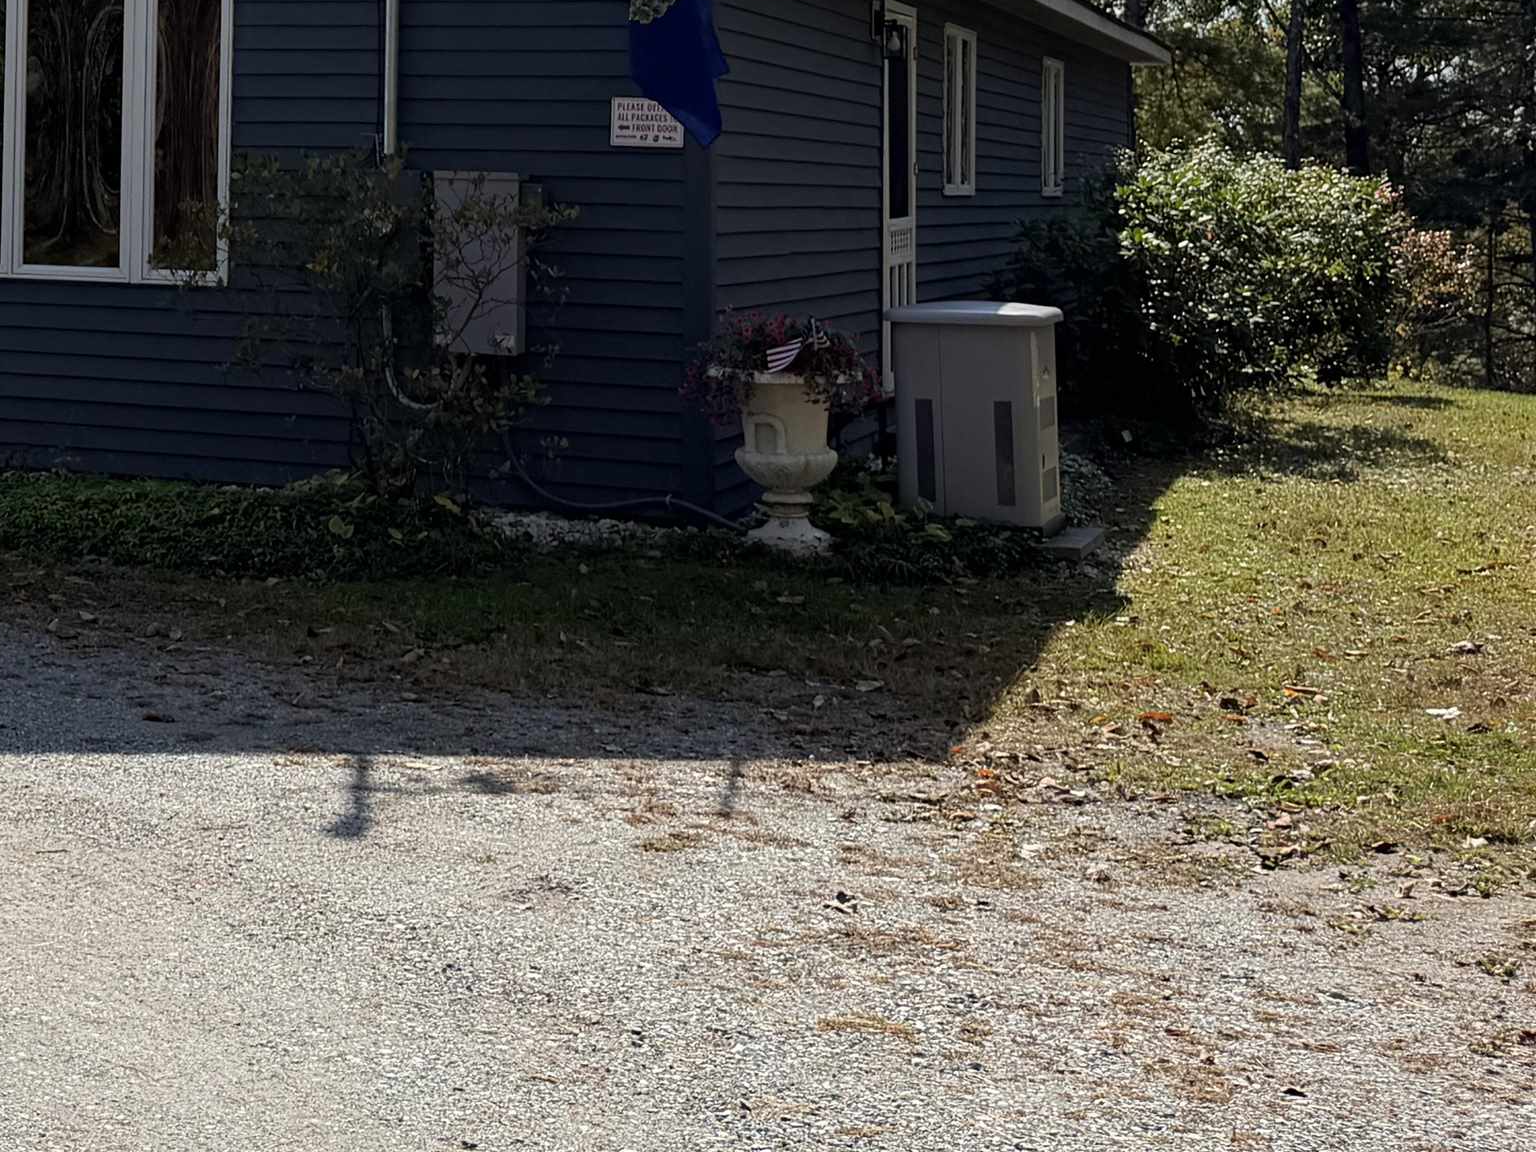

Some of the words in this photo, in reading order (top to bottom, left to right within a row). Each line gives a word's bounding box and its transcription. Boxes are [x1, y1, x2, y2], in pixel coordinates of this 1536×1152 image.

[617, 102, 644, 111] PLEASE
[618, 112, 628, 121] ALL
[631, 113, 668, 122] PACKAGES
[632, 123, 655, 133] FRONT
[657, 124, 678, 134] DOOR
